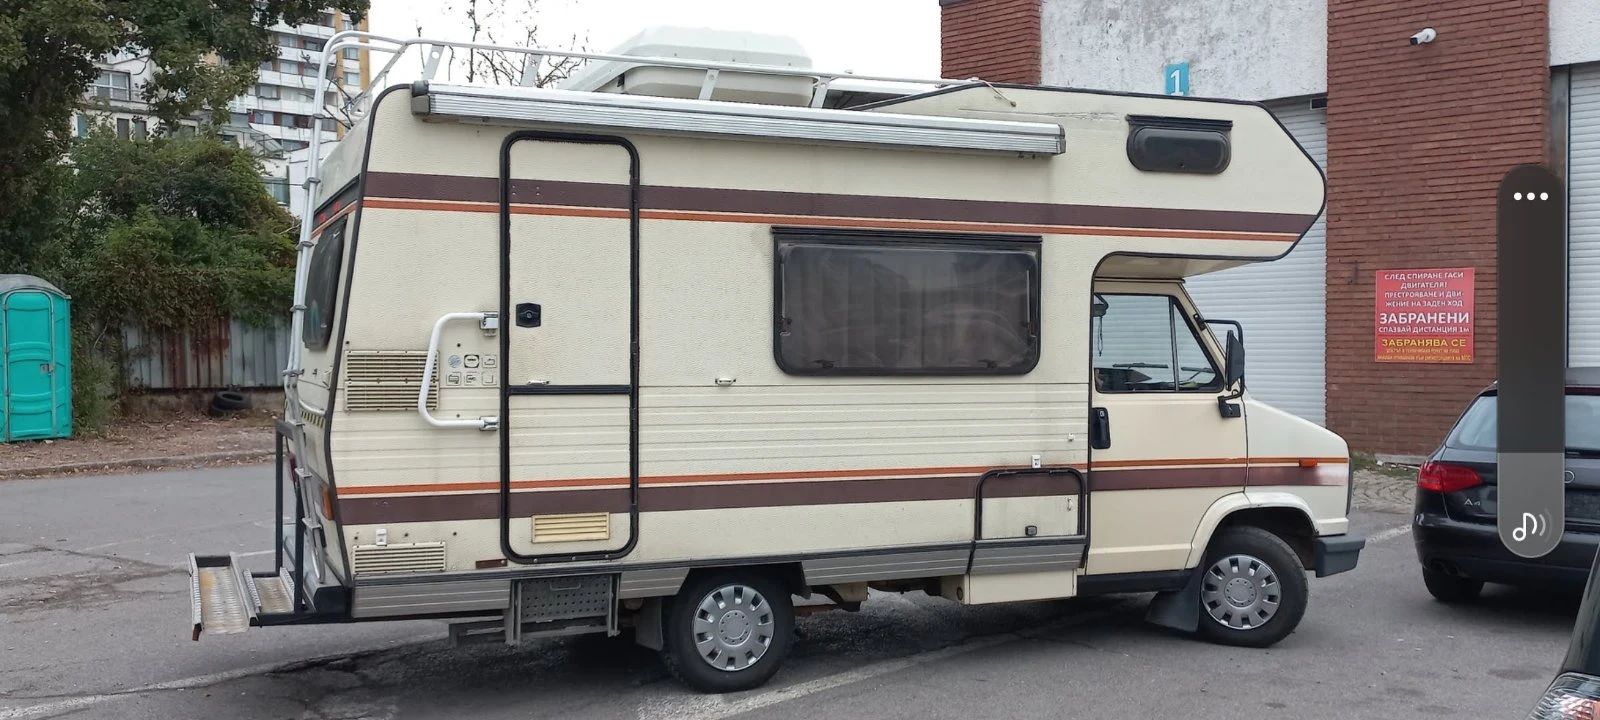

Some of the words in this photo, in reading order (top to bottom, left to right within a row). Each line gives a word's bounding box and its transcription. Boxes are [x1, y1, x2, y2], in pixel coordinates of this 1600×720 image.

[1170, 69, 1184, 96] 1
[1379, 312, 1469, 324] ЗАБРАНЕНИ
[1378, 325, 1411, 333] СПАЗВАЙ
[1412, 326, 1457, 334] ДИСТАНЦИЯ
[1382, 339, 1448, 347] ЗАБРАНЯВА
[1451, 339, 1466, 347] СЕ
[1464, 498, 1481, 506] A4
